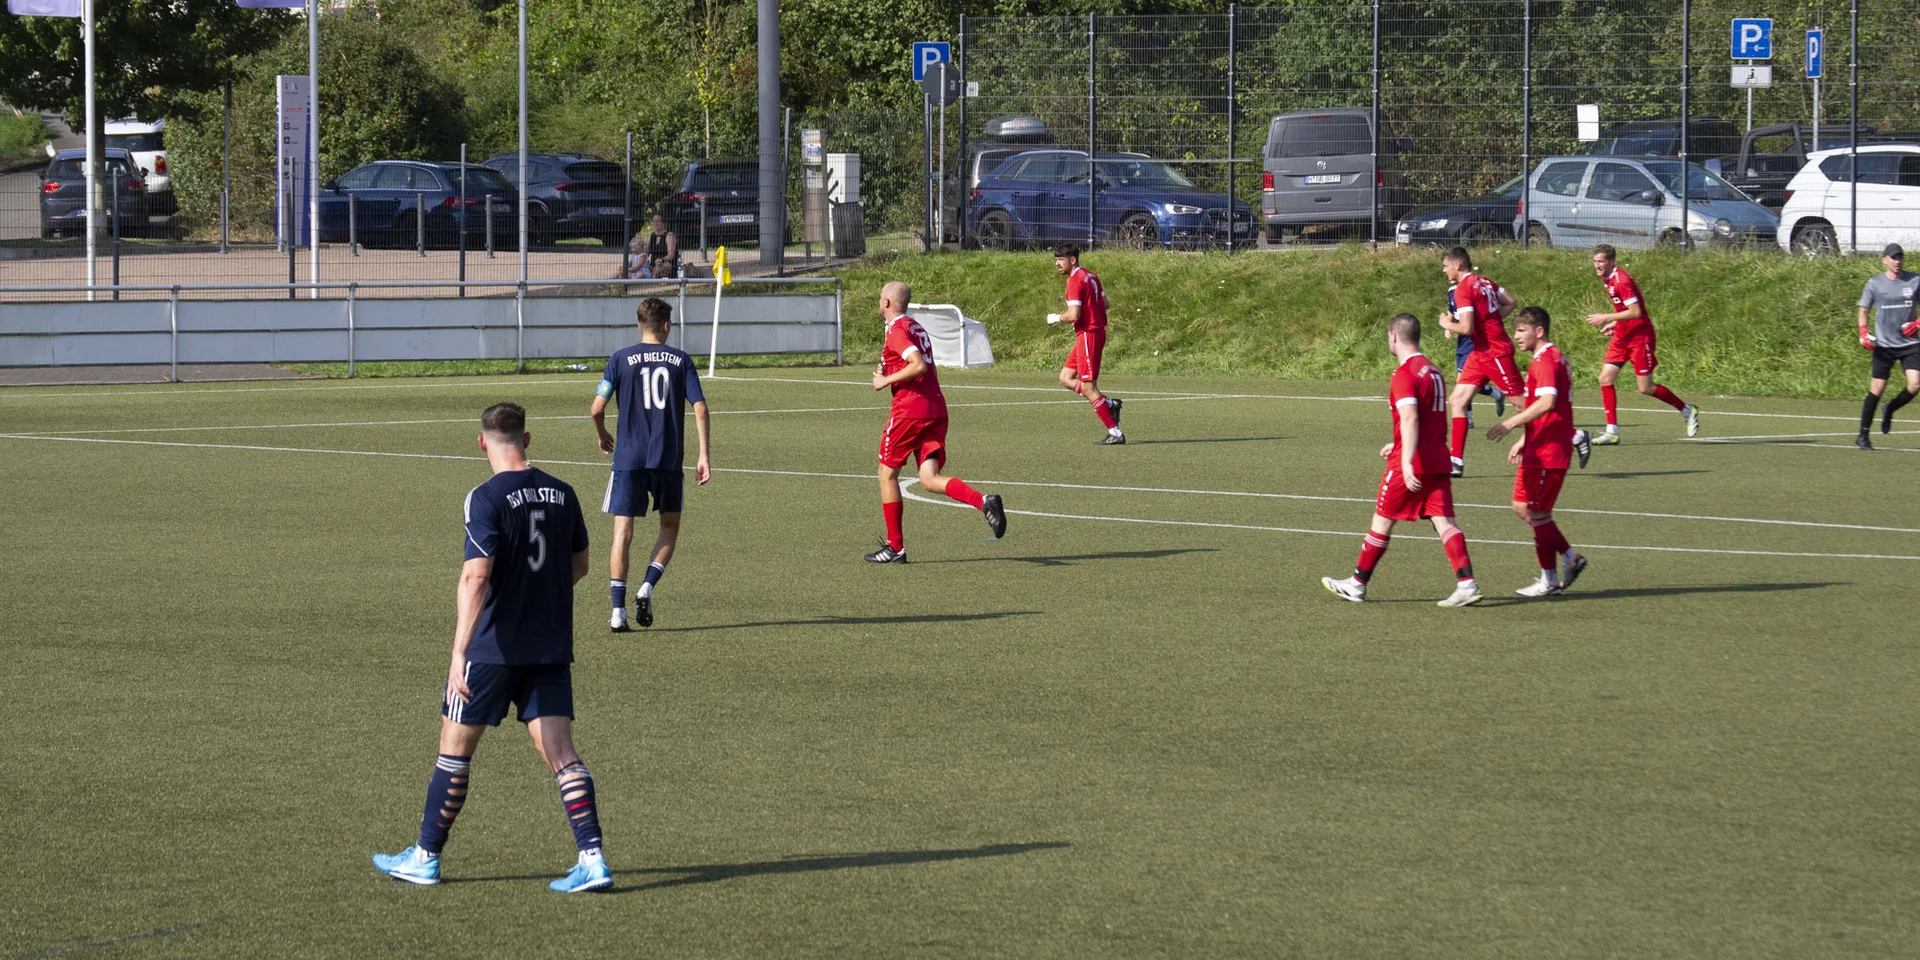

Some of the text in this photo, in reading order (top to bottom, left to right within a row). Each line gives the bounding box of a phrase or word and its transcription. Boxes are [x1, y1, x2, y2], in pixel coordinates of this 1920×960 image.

[1741, 24, 1763, 53] P
[1809, 36, 1819, 72] P
[922, 47, 942, 76] P
[627, 351, 682, 367] BSV BIELSTEIN
[639, 366, 670, 410] 10
[1430, 373, 1445, 412] 11
[506, 487, 565, 509] BSV BIELSTEIN
[527, 509, 547, 572] 5
